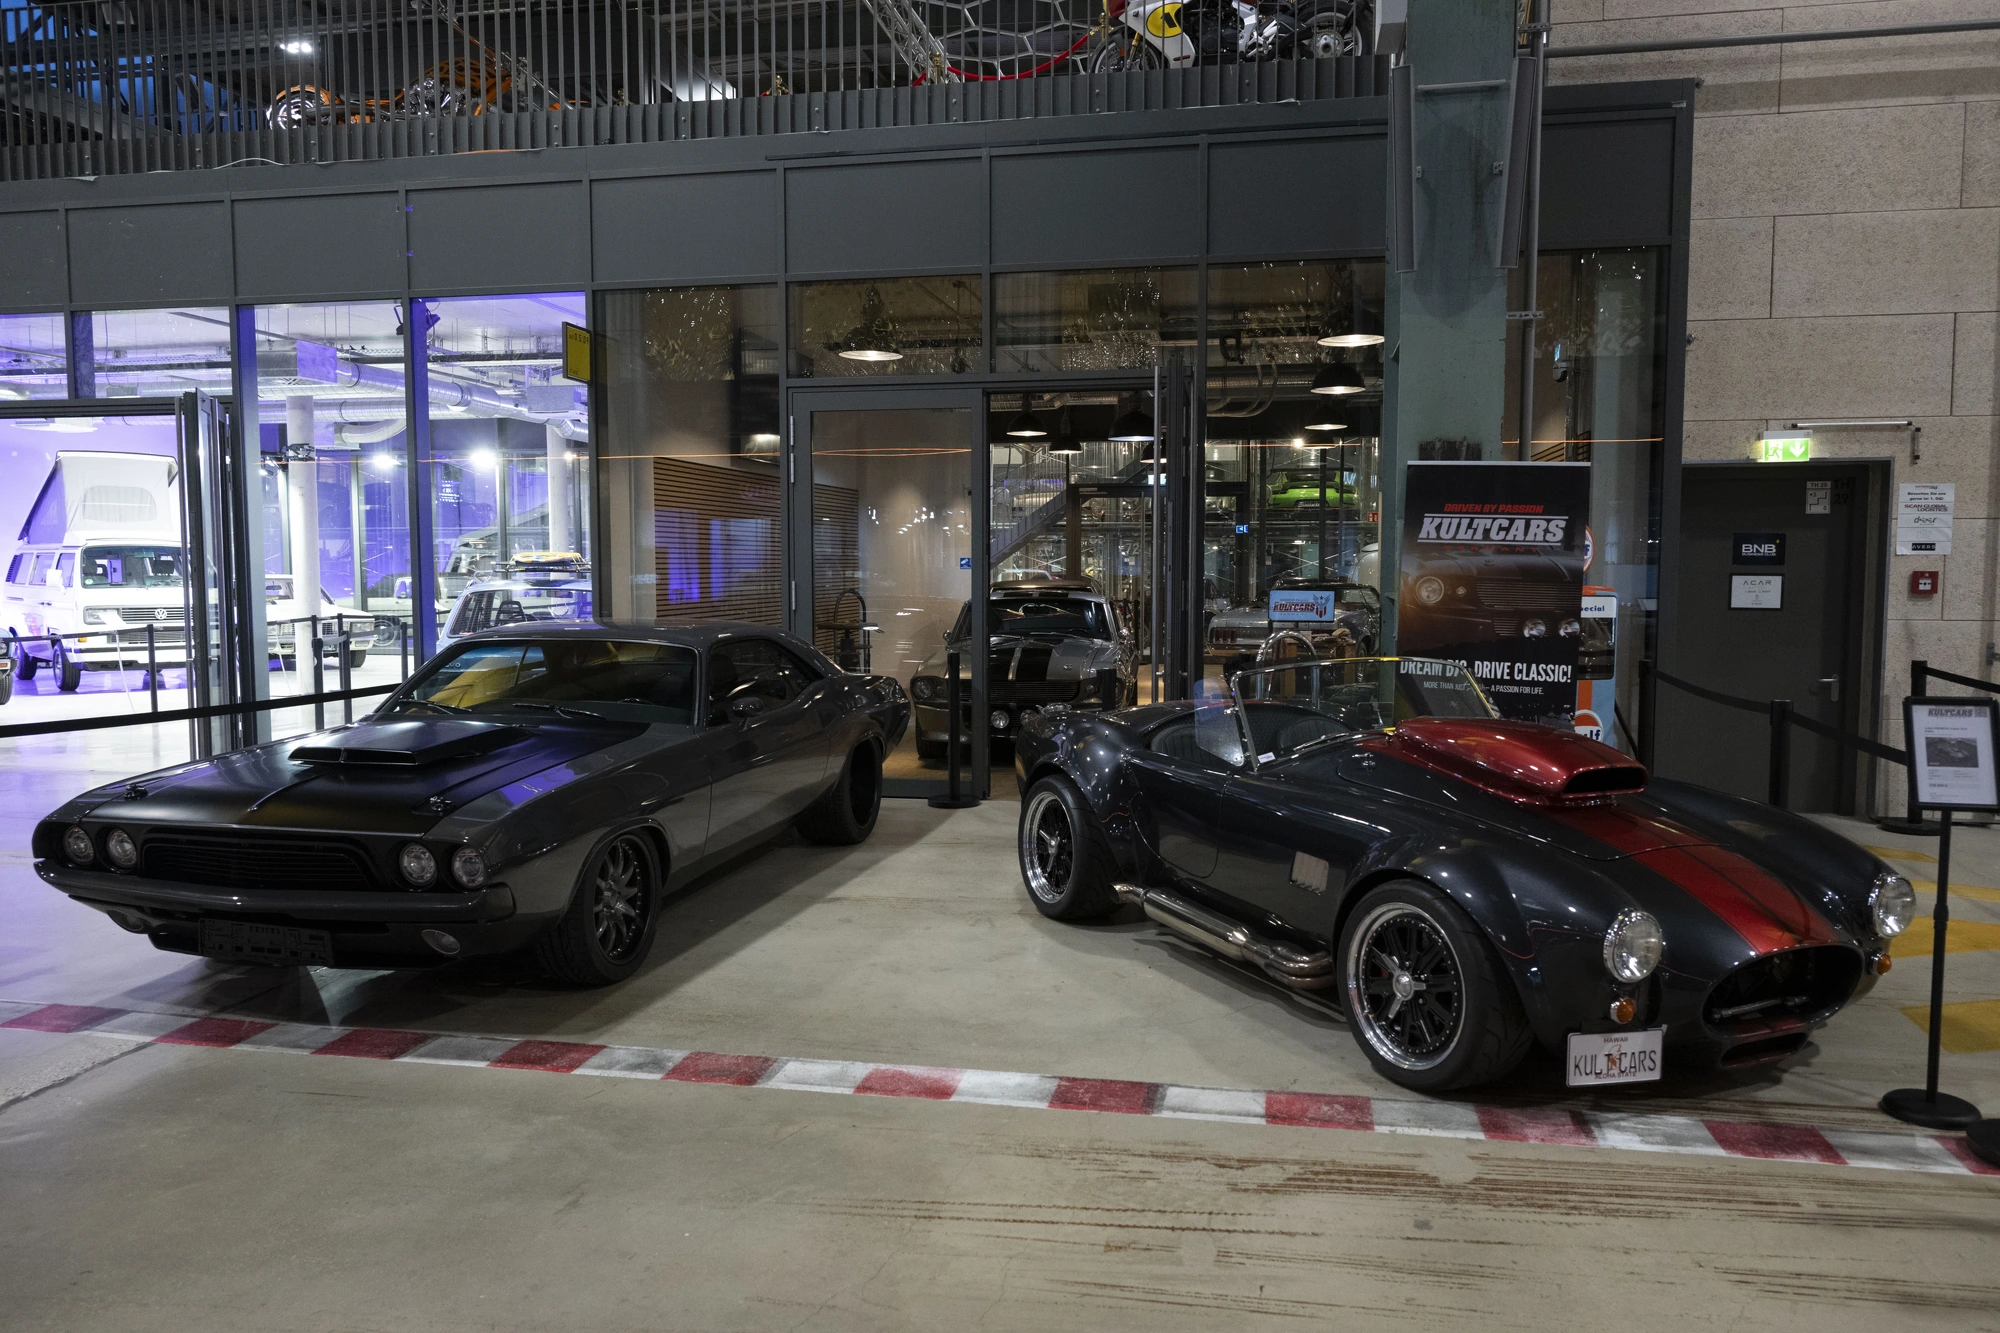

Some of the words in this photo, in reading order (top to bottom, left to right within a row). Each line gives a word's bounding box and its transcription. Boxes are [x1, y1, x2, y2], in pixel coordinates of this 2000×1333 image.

[1444, 503, 1481, 513] DRIVEN
[1483, 504, 1497, 513] BY
[1498, 504, 1544, 514] PASSION
[1418, 517, 1567, 542] KULTCARS
[1741, 543, 1777, 553] BNB
[1273, 603, 1316, 612] KULTCARS
[1400, 661, 1442, 677] DREAM
[1474, 660, 1511, 680] DRIVE
[1514, 662, 1572, 683] CLASSIC!
[1423, 681, 1439, 689] MORE
[1439, 681, 1453, 690] THAN
[1498, 685, 1520, 694] PASSION
[1519, 686, 1531, 694] FOR
[1928, 708, 1973, 717] KULTCARS
[1603, 1036, 1629, 1044] HAWAII
[1574, 1053, 1613, 1077] KULT
[1620, 1050, 1657, 1074] CARS
[1594, 1072, 1616, 1080] ALOHA
[1617, 1070, 1637, 1078] STATE
